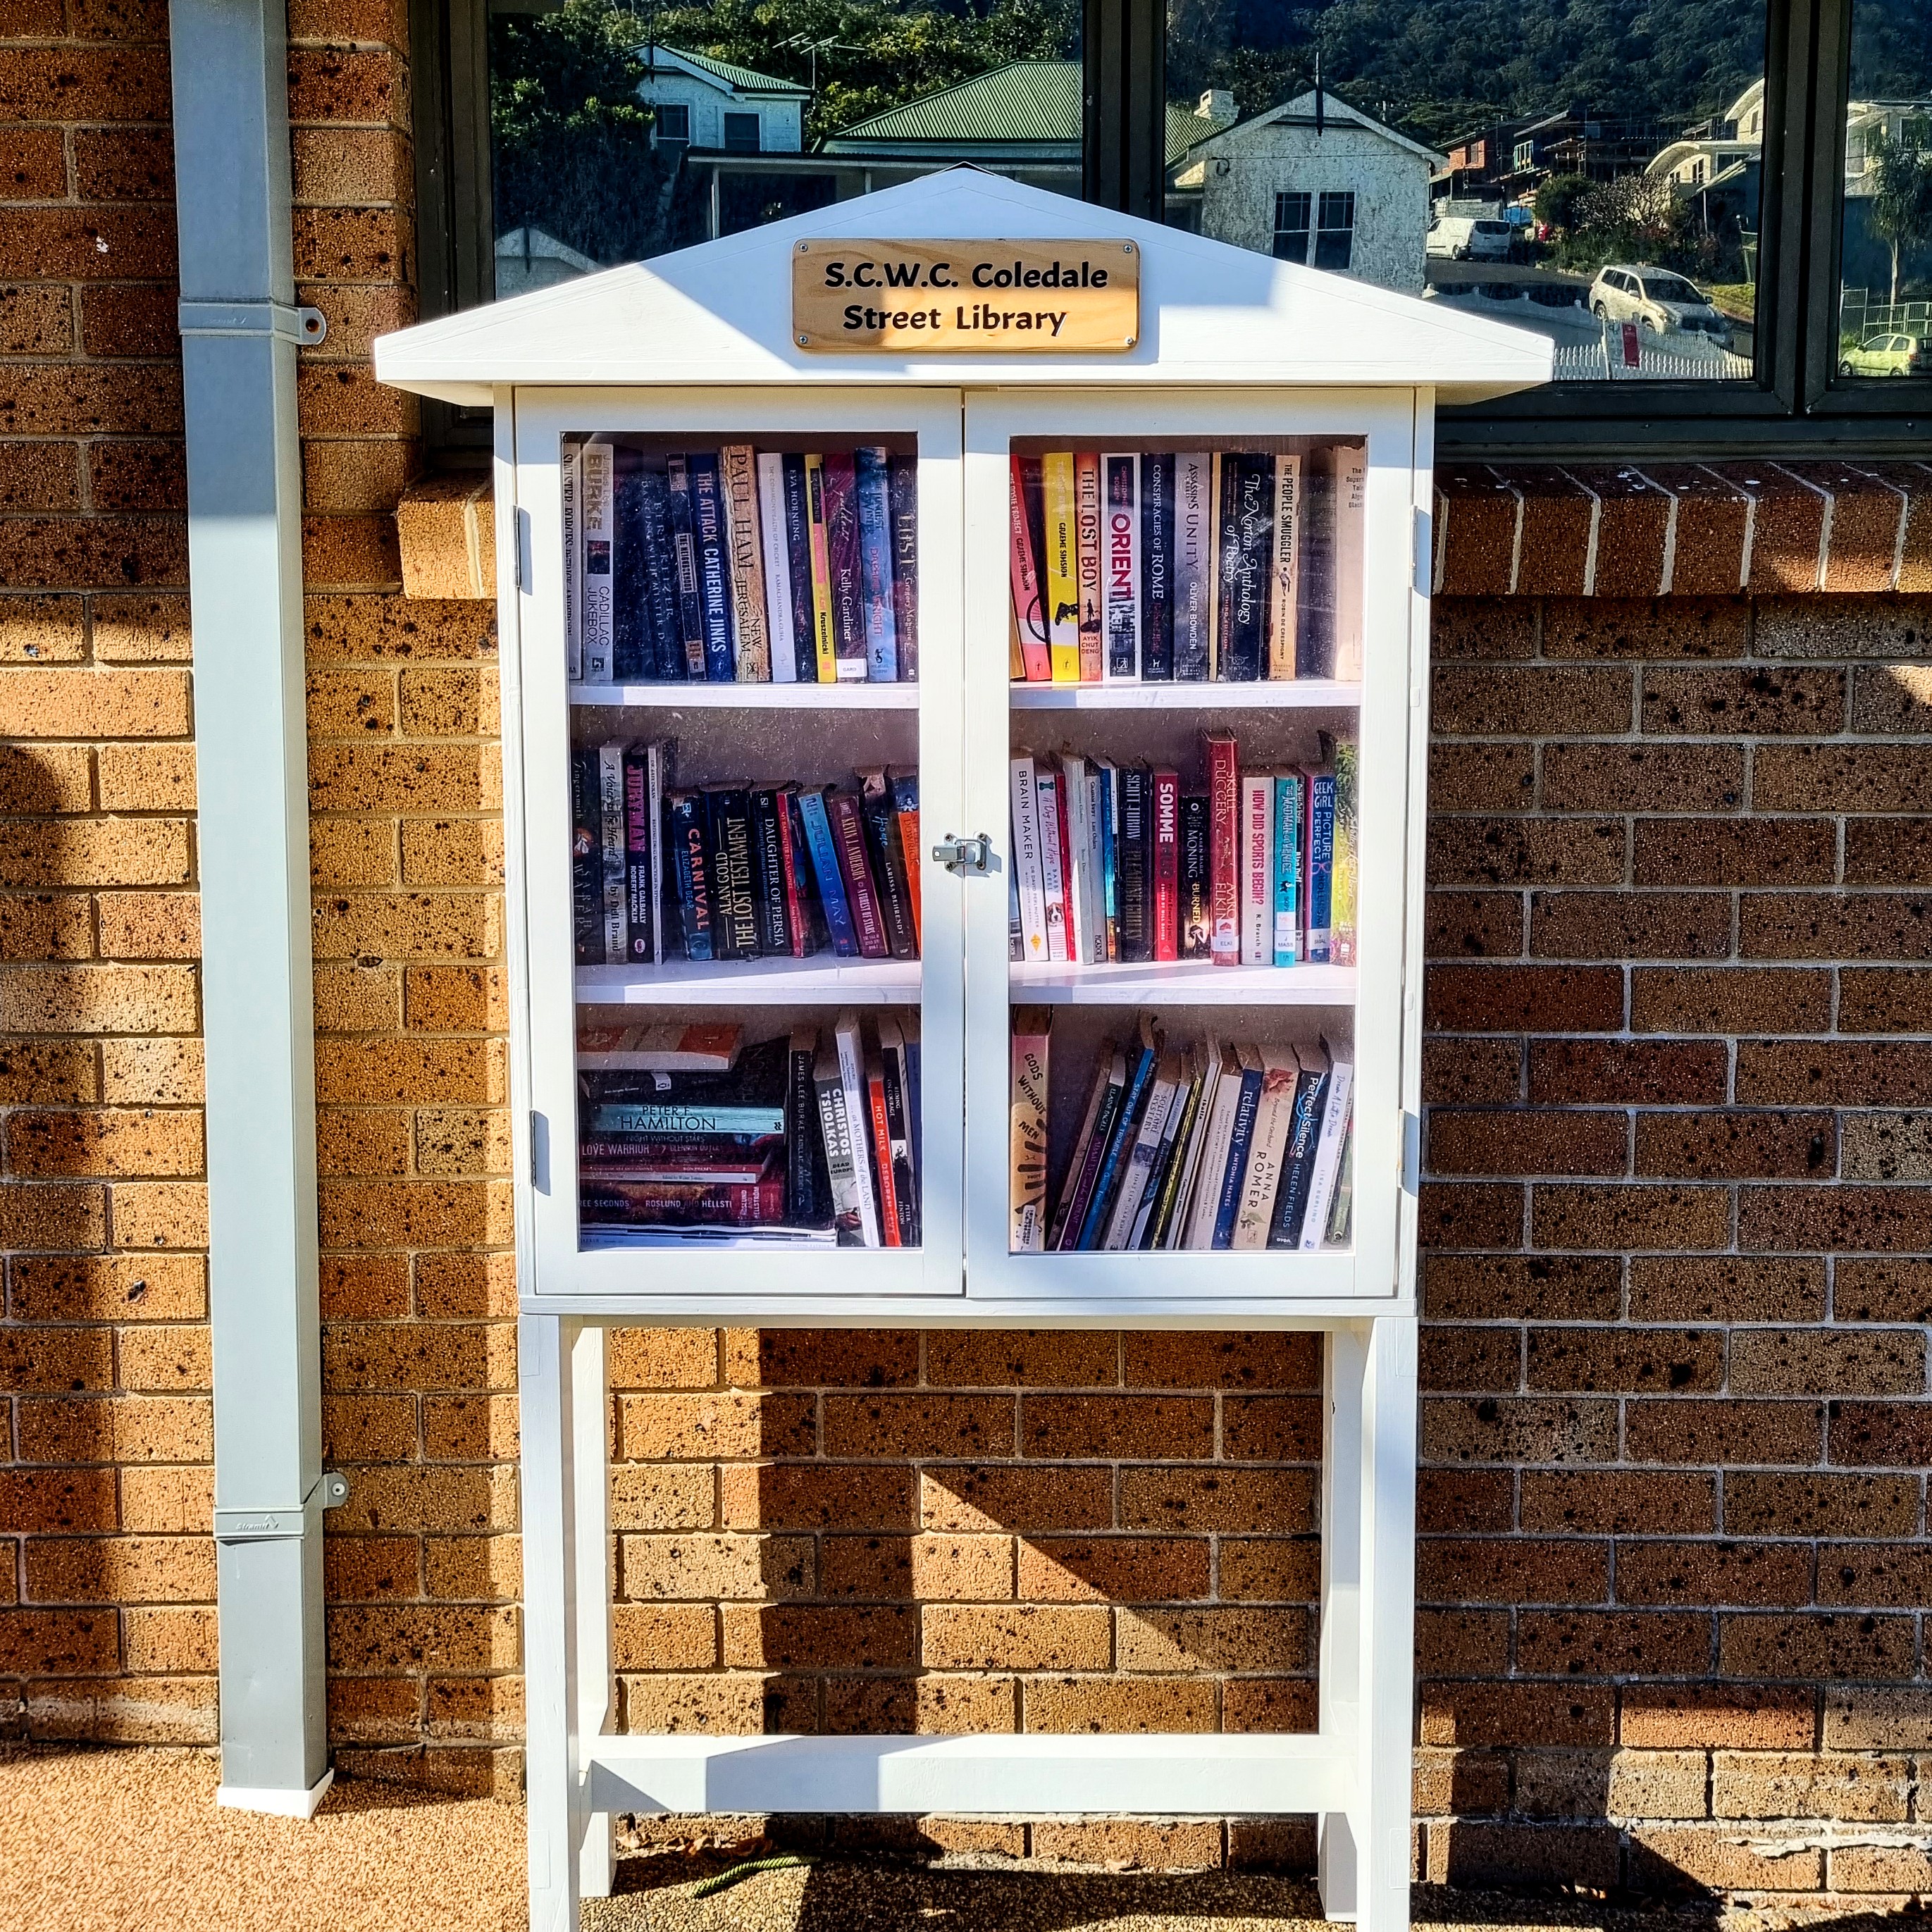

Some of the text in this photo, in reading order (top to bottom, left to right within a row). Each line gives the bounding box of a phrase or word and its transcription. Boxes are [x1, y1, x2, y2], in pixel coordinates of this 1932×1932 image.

[824, 261, 1108, 288] S.C.W.C. Coledale
[843, 304, 1067, 336] Street Library
[588, 454, 603, 530] BURKE
[789, 469, 798, 488] EVA
[1284, 464, 1293, 476] THE
[730, 453, 755, 570] PAUL HAM
[790, 490, 800, 541] HORNUNG
[1152, 464, 1162, 536] CONSPIRACIES
[1281, 478, 1294, 512] PEOPLE
[1058, 522, 1067, 549] GRAEME
[1081, 469, 1097, 591] THE LOST BOY
[1153, 538, 1162, 551] OF
[1186, 514, 1198, 570] UNITY
[1224, 525, 1239, 540] of
[1235, 473, 1261, 626] The Norton Anthology
[1279, 515, 1292, 563] SMUGGLER
[698, 471, 726, 652] THE ATTACK CATHERINE JINKS
[1110, 513, 1132, 600] ORIENT
[1151, 553, 1164, 600] ROME
[1222, 540, 1239, 583] Poetry
[588, 588, 599, 645] JUKEBOX
[598, 586, 610, 646] CADILLAC
[735, 578, 751, 652] JERUSALEM
[840, 568, 855, 641] Kelly Gardiner
[1189, 582, 1198, 612] OLIVER
[751, 618, 763, 649] NEW
[573, 760, 587, 819] Fingersmith
[626, 764, 645, 852] JURYMAN
[1018, 770, 1029, 809] BRAIN
[1127, 774, 1141, 803] SCOTT
[1214, 759, 1227, 825] DUGGERY
[1225, 771, 1237, 813] SKULL
[1314, 781, 1333, 794] GEEK
[1314, 795, 1333, 808] GIRL
[841, 817, 857, 838] KEVIN
[872, 815, 889, 848] Home
[1127, 805, 1141, 841] TUROW
[1159, 782, 1174, 843] SOMME
[1281, 795, 1296, 874] MADMAN VENICE
[1322, 811, 1332, 860] PICTURE
[903, 819, 916, 865] DOWRICK
[1022, 815, 1033, 859] MAKER
[1187, 829, 1199, 878] MONING
[1251, 790, 1265, 905] HOW DID SPORTS BEGIN?
[607, 771, 620, 951] Voice Heard by Brand
[681, 850, 692, 888] ELIZABETH
[688, 828, 710, 930] CARNIVAL
[715, 853, 733, 915] ALAN GOLD
[726, 817, 757, 948] THE LOST TESTAMENT
[764, 818, 784, 946] DAUGHTER OF PERSIA
[811, 821, 846, 926] JULIAN MAY
[848, 846, 867, 881] ANDERSON
[1029, 866, 1036, 874] DR
[573, 864, 584, 936] WATERS
[582, 870, 593, 929] SARAH
[885, 861, 904, 934] LARISSA BEHRENDT
[1191, 883, 1201, 924] BURNED
[1023, 1053, 1044, 1081] GODS
[642, 1106, 693, 1116] PETER F.
[874, 1105, 884, 1125] HOT
[887, 1089, 896, 1117] COURAGE
[893, 1086, 902, 1109] RIDING
[1017, 1075, 1046, 1115] WITHOUT
[620, 1115, 716, 1131] HAMILTON
[685, 1134, 705, 1143] STARS
[820, 1090, 840, 1157] TSIOLKAS
[832, 1087, 851, 1156] CHRISTOS
[876, 1129, 886, 1151] MILK
[1017, 1120, 1040, 1140] MEN
[1110, 1083, 1141, 1158] STAY OUT TROUBLE
[1229, 1090, 1255, 1184] relativity ANTONIA
[582, 1144, 650, 1156] LOVE WARRIOR
[853, 1123, 872, 1210] MOTHERS LAND
[1282, 1077, 1320, 1228] Perfect Silence HELEN FIELDS
[1247, 1151, 1267, 1208] ROMER
[1261, 1162, 1276, 1202] ANNA
